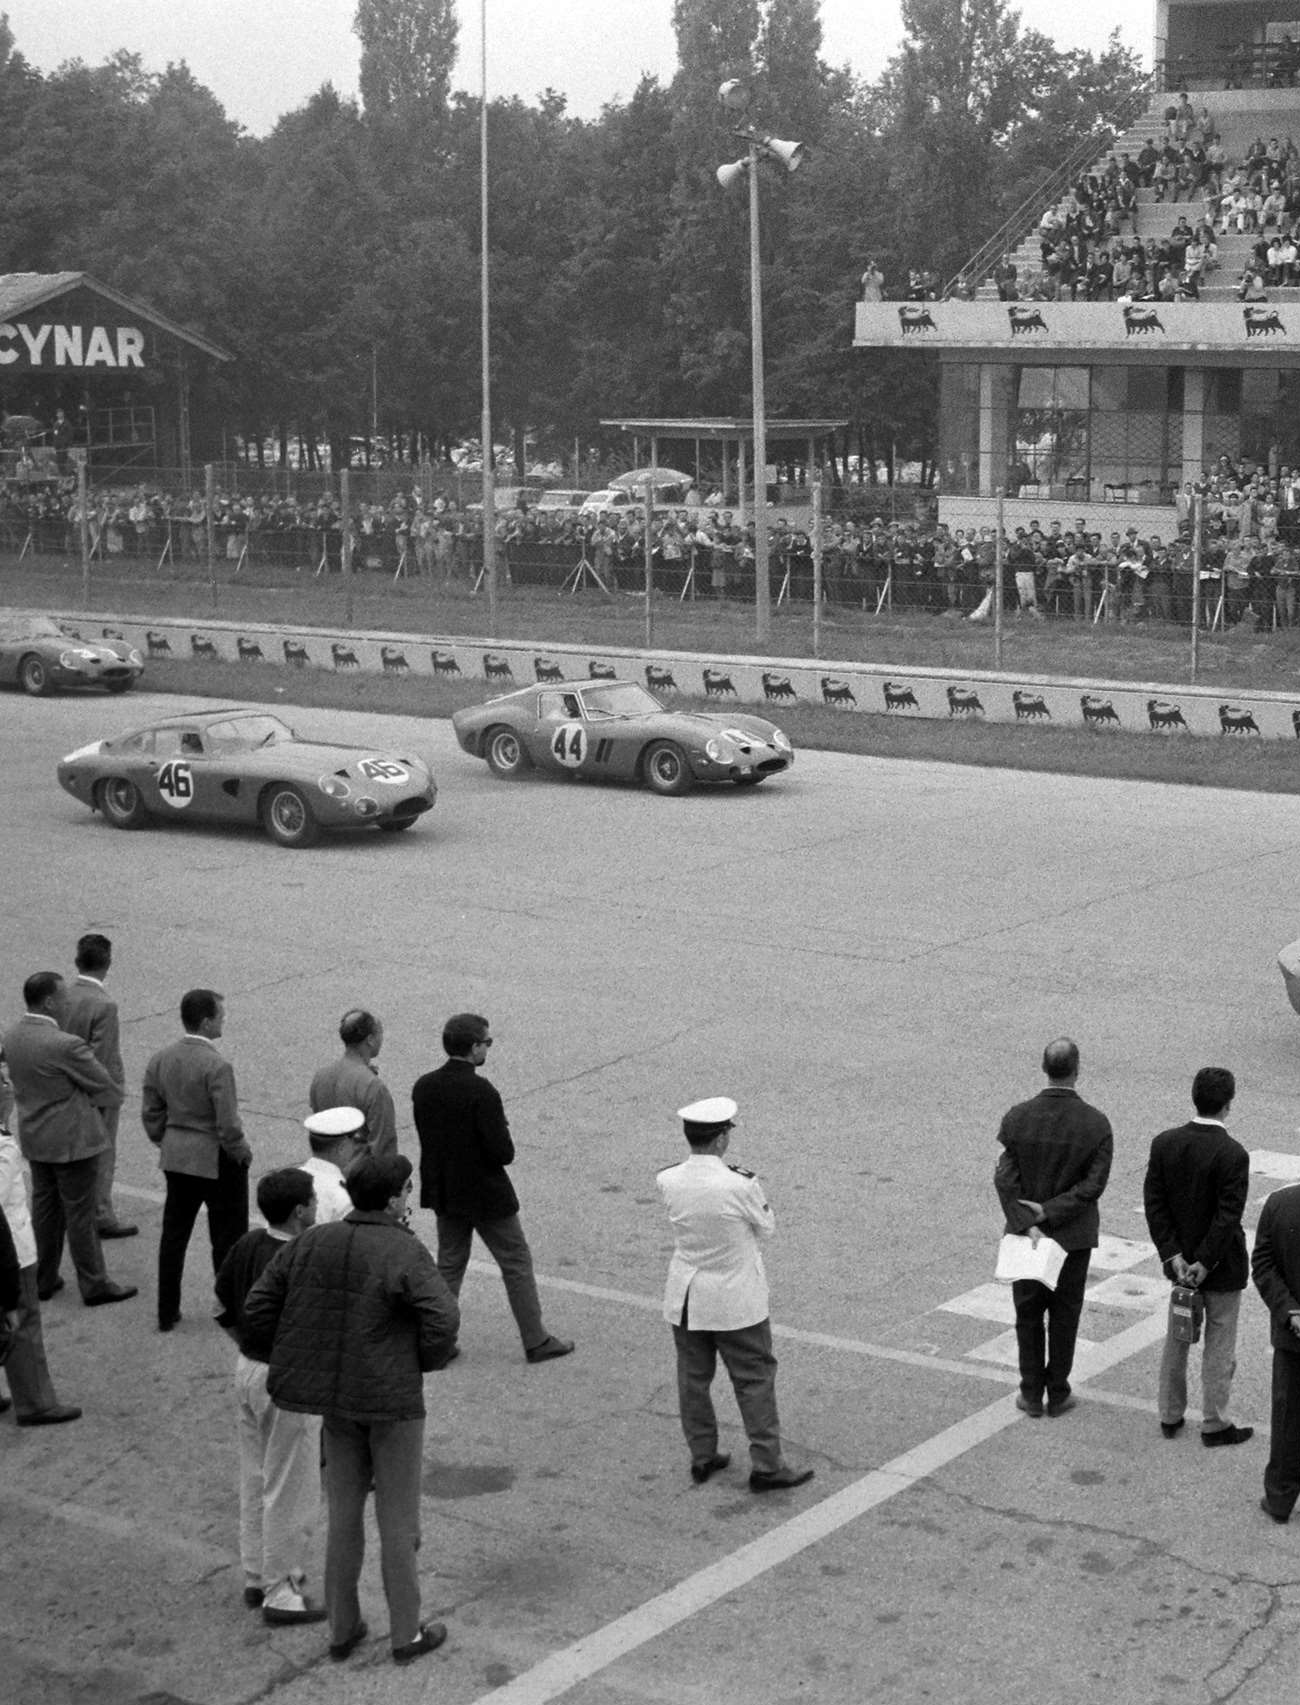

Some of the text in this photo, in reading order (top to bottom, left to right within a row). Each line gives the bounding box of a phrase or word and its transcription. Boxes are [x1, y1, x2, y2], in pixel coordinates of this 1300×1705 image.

[0, 322, 145, 367] CYNAR
[554, 727, 583, 761] 44
[159, 762, 191, 797] 46
[361, 759, 405, 779] 46
